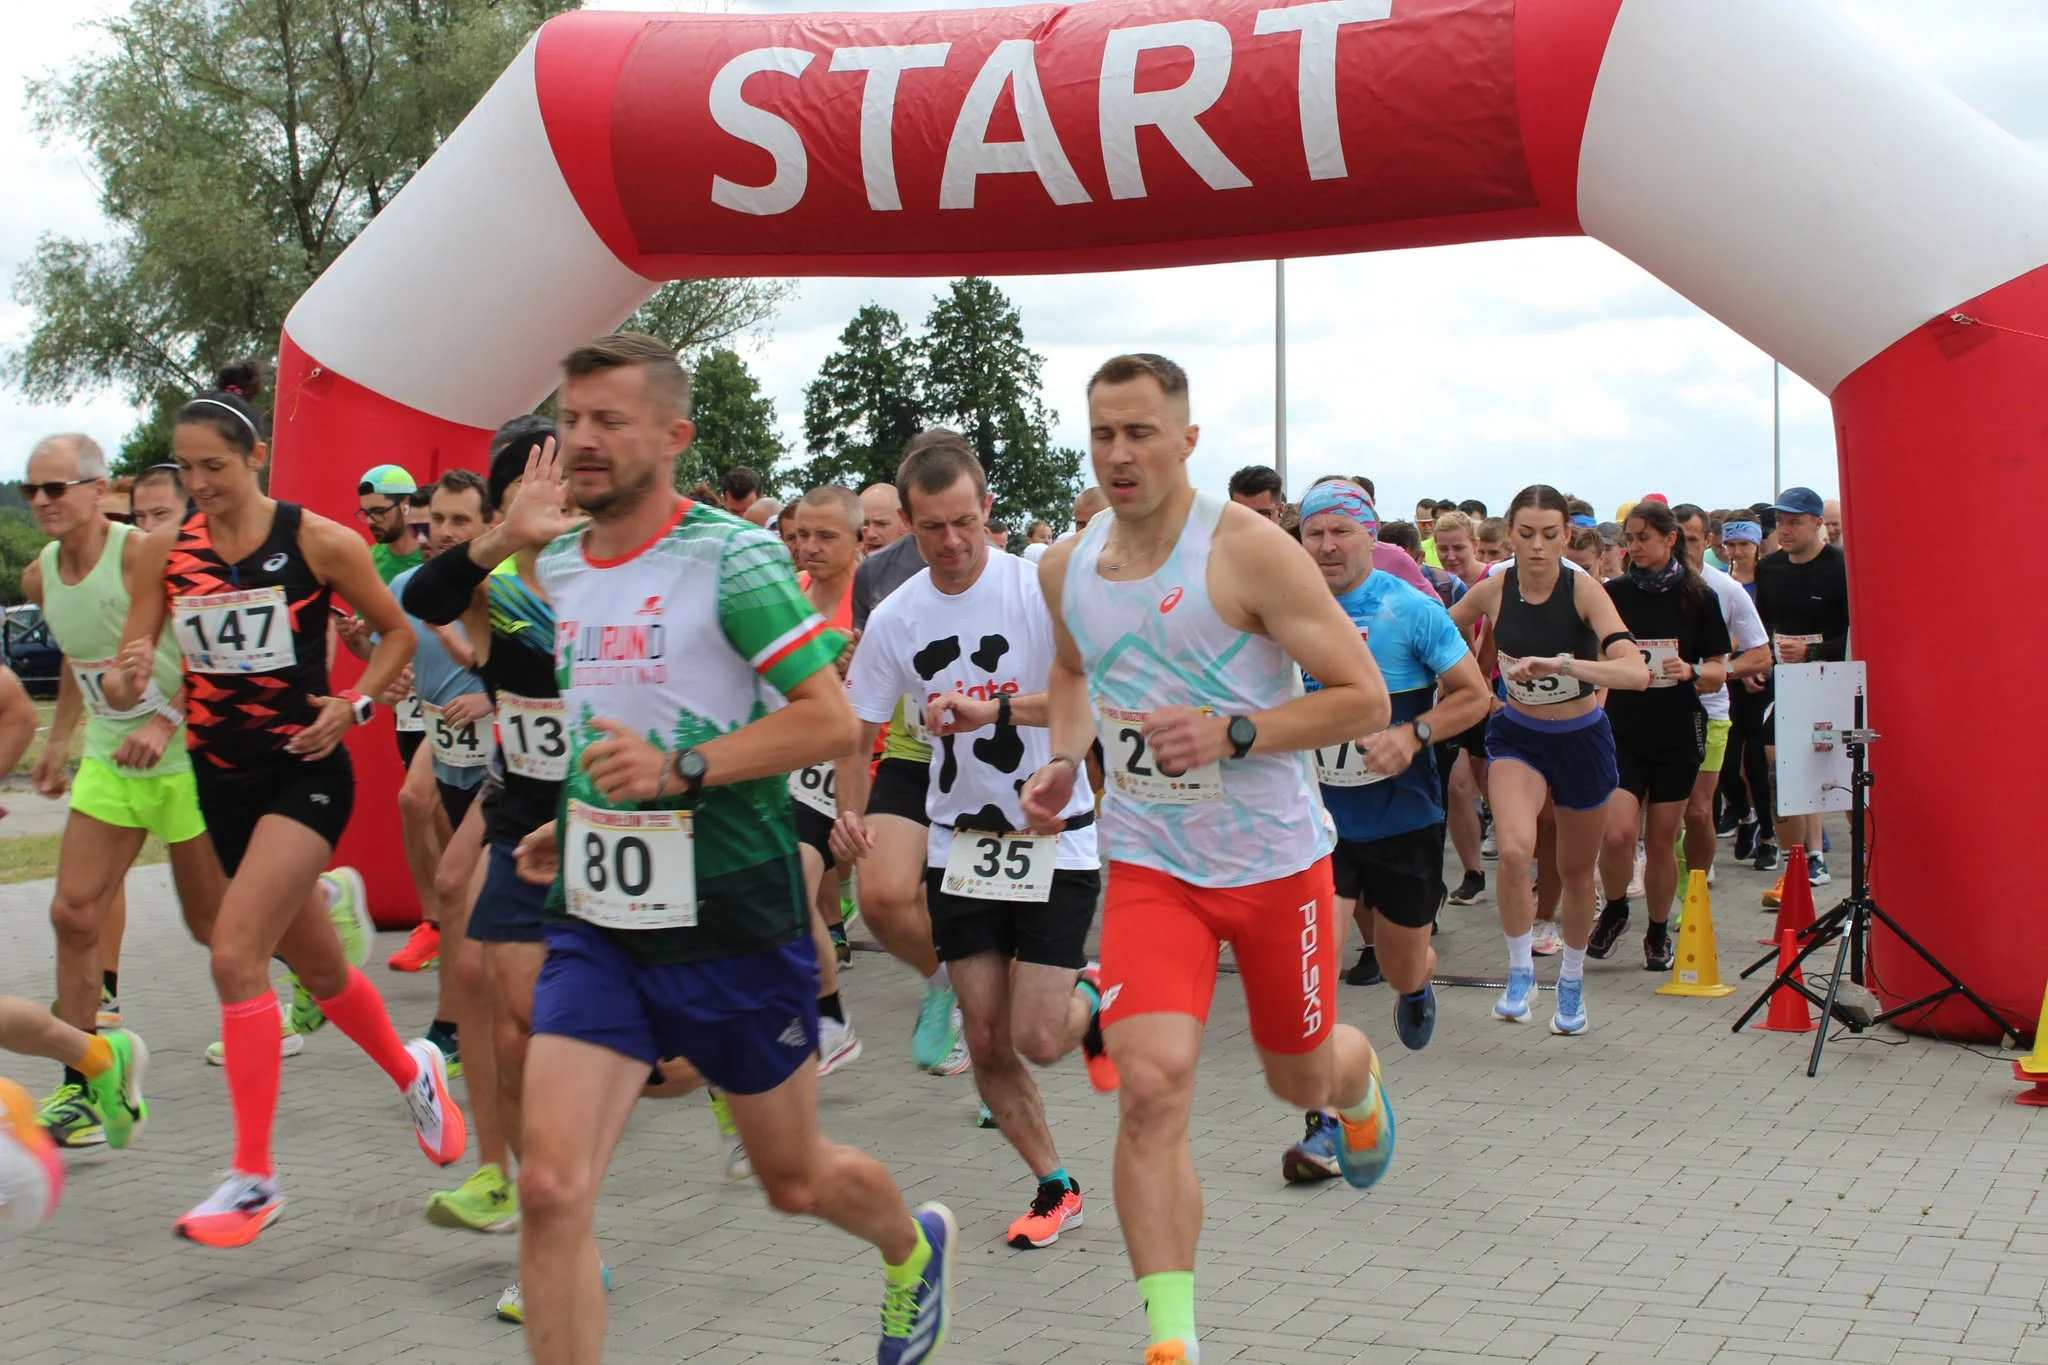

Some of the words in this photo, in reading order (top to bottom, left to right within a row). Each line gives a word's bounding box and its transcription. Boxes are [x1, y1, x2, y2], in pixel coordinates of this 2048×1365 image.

[708, 0, 1392, 216] START
[185, 605, 274, 651] 147
[436, 718, 480, 751] 54
[509, 715, 566, 757] 13
[1120, 728, 1187, 778] 2
[586, 831, 652, 896] 80
[973, 838, 1034, 880] 35
[1299, 899, 1322, 1037] POLSKA
